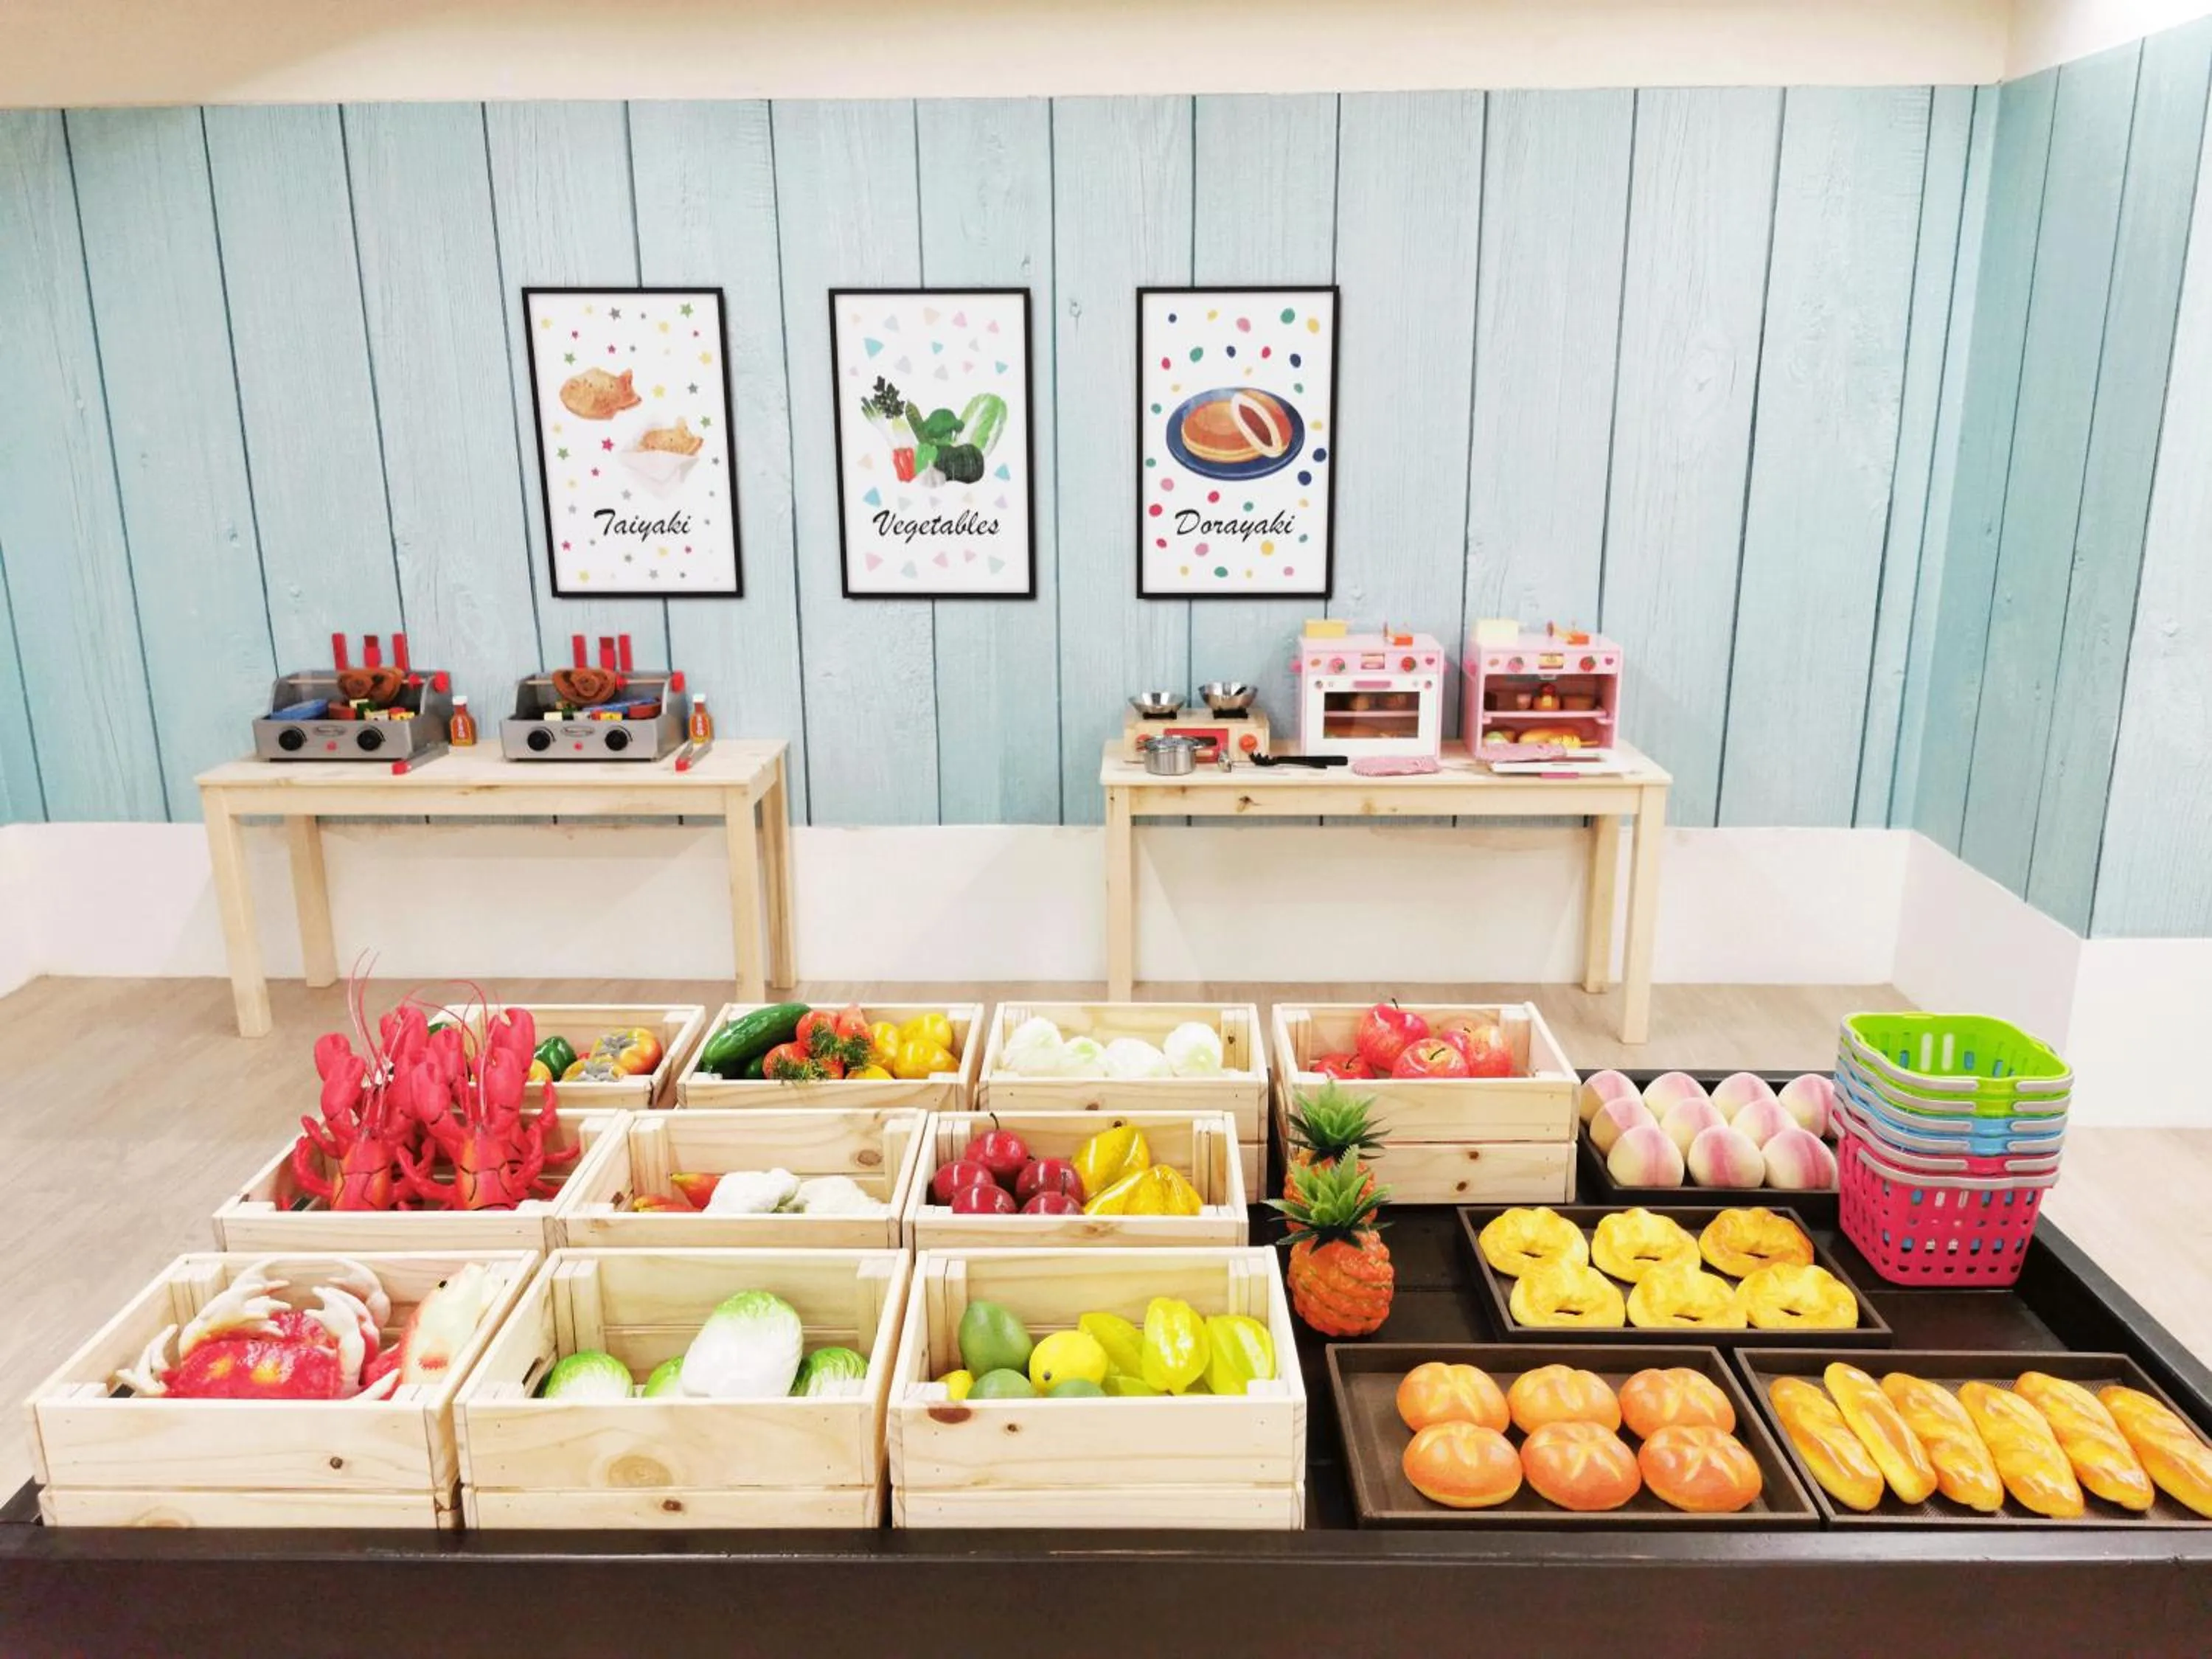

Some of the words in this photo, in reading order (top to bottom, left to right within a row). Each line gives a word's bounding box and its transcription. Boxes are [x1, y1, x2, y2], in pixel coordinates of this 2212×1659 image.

[594, 508, 691, 542] Taiyaki
[872, 509, 999, 543] Vegetables
[1175, 509, 1295, 542] Dorayaki
